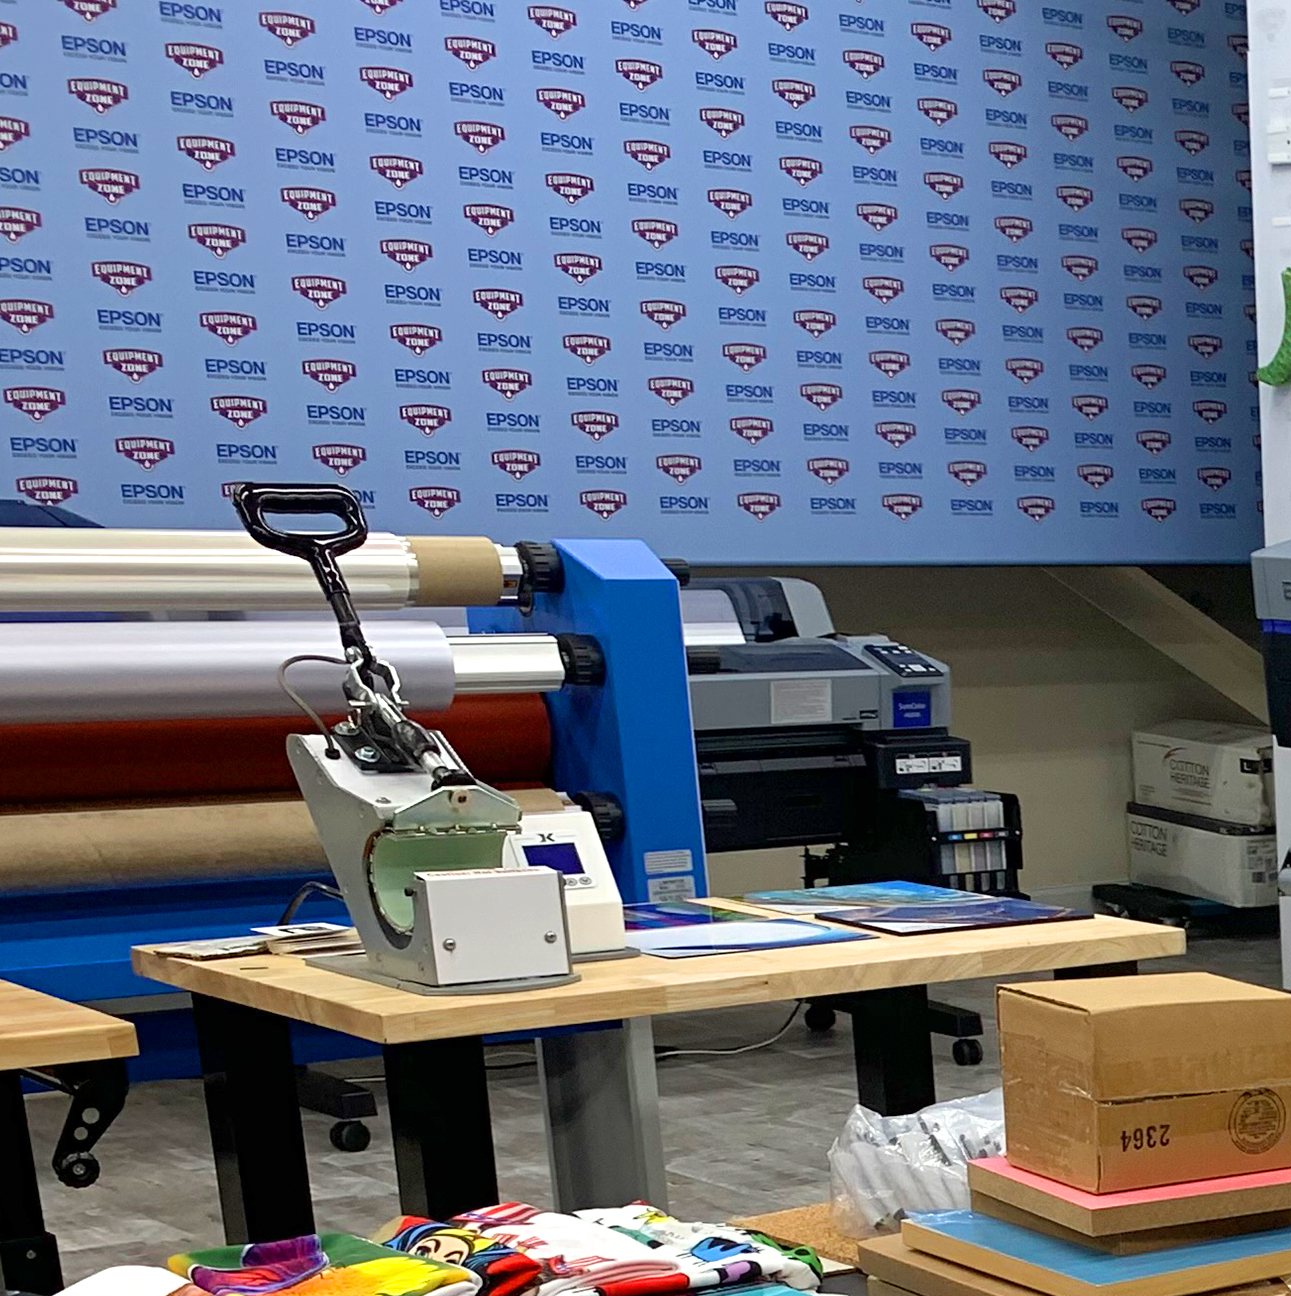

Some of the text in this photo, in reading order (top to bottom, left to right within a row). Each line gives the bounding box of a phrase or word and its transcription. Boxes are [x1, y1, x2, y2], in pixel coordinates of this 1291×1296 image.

[160, 2, 221, 21] EPSON
[532, 7, 574, 19] EQUIPMENT
[1042, 8, 1082, 22] EPSON
[262, 14, 312, 28] EQUIPMENT
[543, 17, 565, 26] ZONE
[275, 25, 302, 36] ZONE
[611, 22, 661, 39] EPSON
[70, 81, 125, 97] EQUIPMENT
[84, 94, 114, 105] ZONE
[846, 91, 890, 106] EPSON
[365, 113, 421, 130] EPSON
[992, 181, 1032, 195] EPSON
[85, 218, 149, 234] EPSON
[550, 217, 601, 234] EPSON
[634, 221, 675, 233] EQUIPMENT
[645, 230, 666, 239] ZONE
[711, 231, 758, 245] EPSON
[381, 241, 429, 255] EQUIPMENT
[1181, 236, 1218, 249] EPSON
[394, 252, 420, 263] ZONE
[297, 322, 354, 341] EPSON
[866, 317, 909, 332] EPSON
[1069, 365, 1108, 379] EPSON
[726, 385, 772, 397] EPSON
[10, 438, 76, 454] EPSON
[118, 439, 171, 454] EQUIPMENT
[314, 445, 363, 460] EQUIPMENT
[132, 451, 160, 462] ZONE
[327, 457, 353, 467] ZONE
[405, 451, 460, 469] EPSON
[576, 456, 626, 468] EPSON
[583, 492, 624, 504] EQUIPMENT
[594, 502, 616, 510] ZONE
[951, 500, 992, 514] EPSON
[1199, 503, 1236, 516] EPSON
[1169, 758, 1210, 777] COTTON
[1169, 773, 1211, 790] HERITAGE
[1131, 820, 1169, 840] COTTON
[1120, 1124, 1171, 1152] 2364
